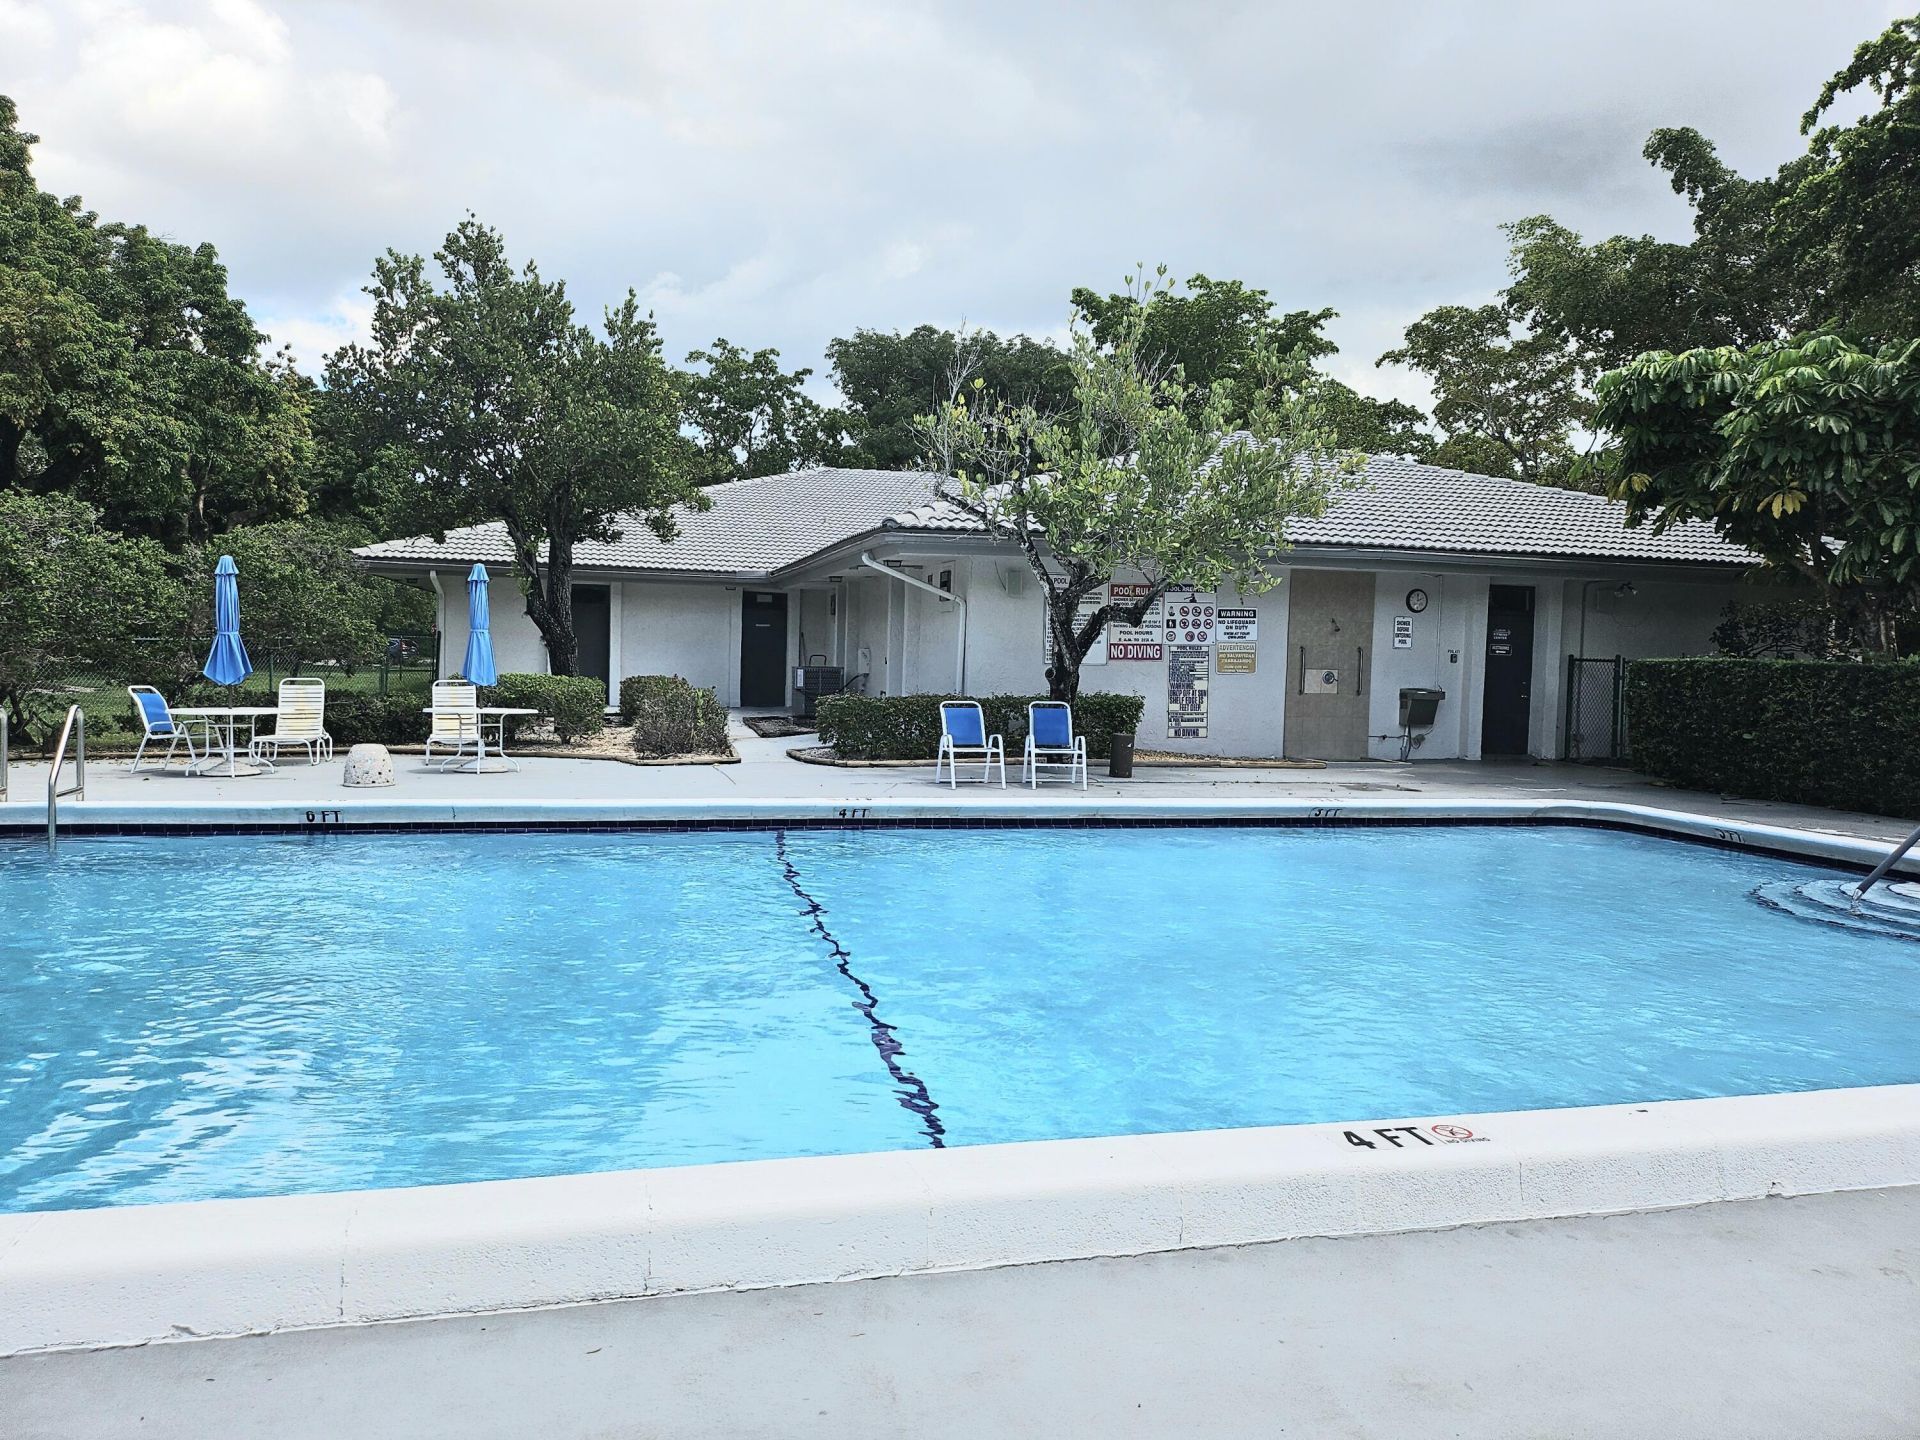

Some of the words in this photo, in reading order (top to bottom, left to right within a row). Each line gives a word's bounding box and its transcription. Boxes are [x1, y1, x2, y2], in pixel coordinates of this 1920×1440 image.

[1114, 586, 1134, 594] POOL
[1110, 645, 1124, 659] NO
[1127, 645, 1161, 659] DIVING
[306, 810, 315, 822] 6
[321, 810, 341, 822] FT
[839, 808, 847, 818] 4
[852, 808, 870, 818] FT
[1343, 1131, 1377, 1150] 4
[1373, 1126, 1434, 1148] FT
